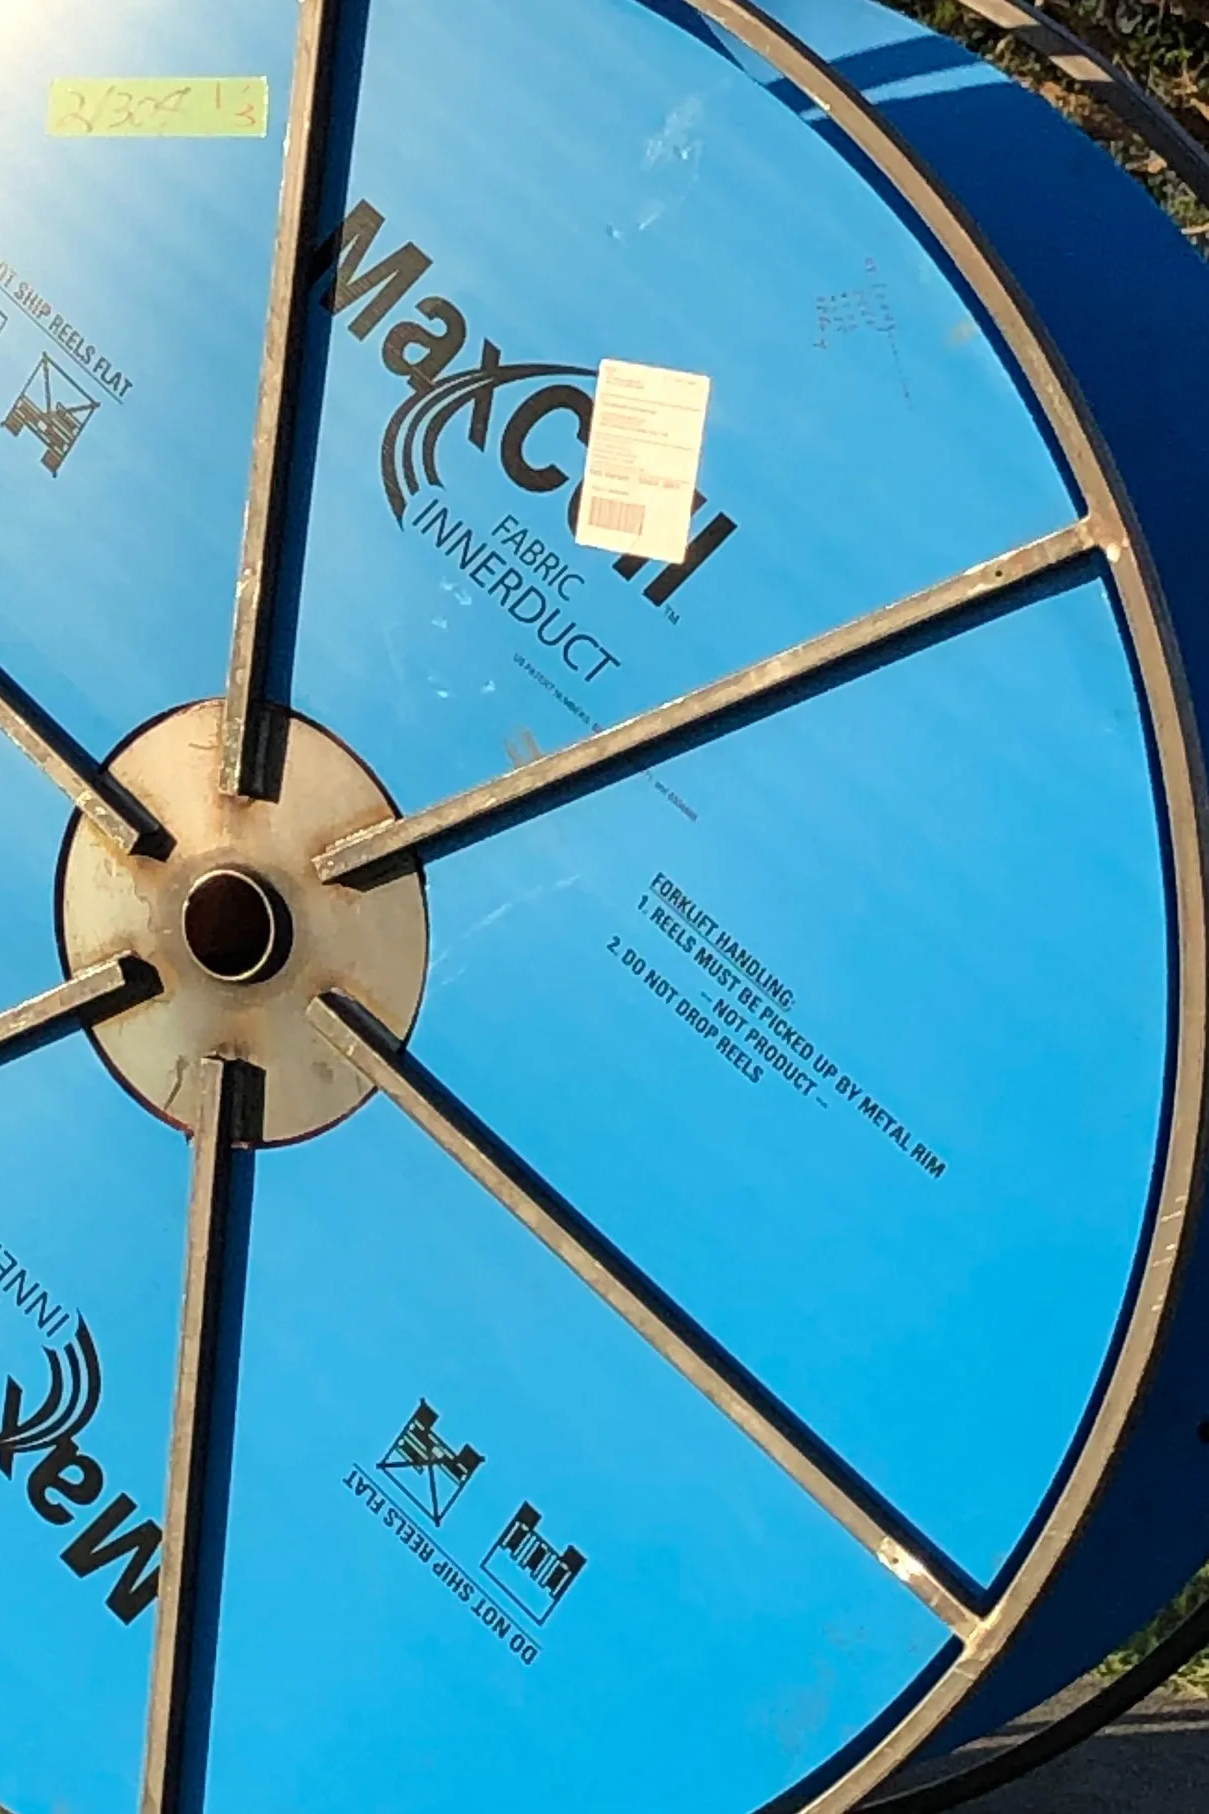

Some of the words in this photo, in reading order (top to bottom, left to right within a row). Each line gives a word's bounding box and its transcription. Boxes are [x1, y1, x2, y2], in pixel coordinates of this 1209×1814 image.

[13, 281, 52, 321] SHIP
[48, 314, 96, 363] REELS
[92, 357, 133, 398] FLAT
[308, 198, 738, 607] MaxCl
[412, 499, 621, 682] INNERDUCT
[491, 515, 585, 602] FABRIC
[650, 872, 719, 939] FORKLIFT
[621, 948, 646, 977] DO
[643, 968, 679, 1006] NOT
[675, 998, 720, 1042] DROP
[716, 1035, 764, 1084] REELS
[649, 906, 697, 954] REELS
[693, 947, 742, 993] MUST
[738, 986, 763, 1012] BE
[759, 1005, 815, 1062] PICKED
[812, 1054, 839, 1081] UP
[835, 1076, 863, 1102] BY
[858, 1096, 910, 1152] METAL
[910, 1143, 947, 1180] RIM
[712, 998, 749, 1034] NOT
[744, 1027, 818, 1098] PRODUCT
[342, 1470, 387, 1515] FLAT
[382, 1507, 435, 1564] REELS
[432, 1560, 475, 1602] SHIP
[471, 1598, 512, 1640] NOT
[509, 1633, 538, 1665] DO
